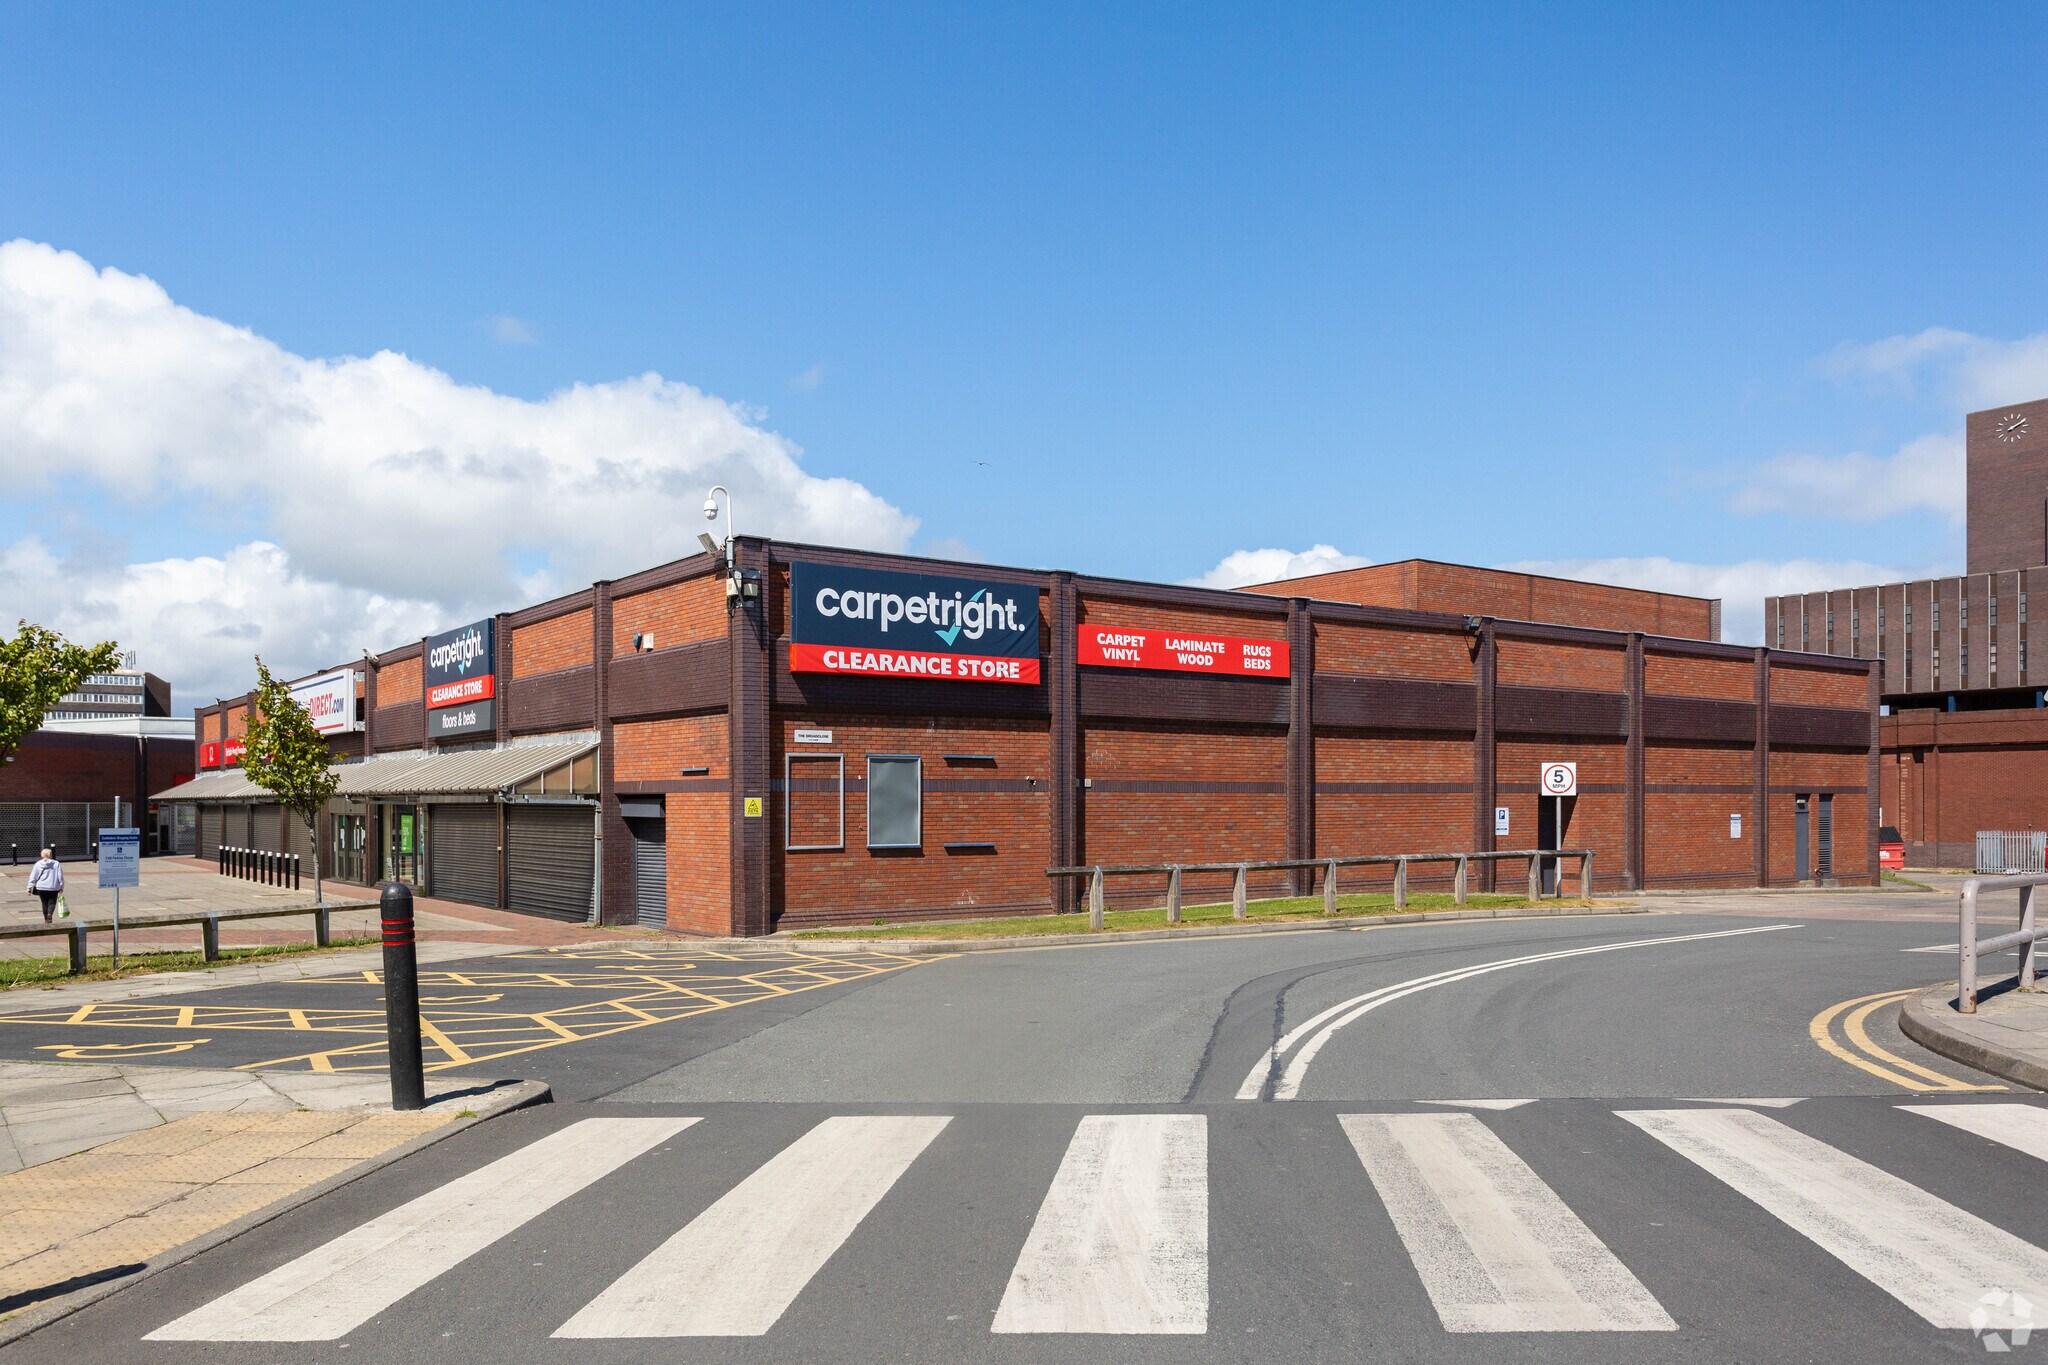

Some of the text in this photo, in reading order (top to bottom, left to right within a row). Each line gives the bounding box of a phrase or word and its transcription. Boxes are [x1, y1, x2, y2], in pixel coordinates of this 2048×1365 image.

[1096, 632, 1146, 648] CARPET
[1165, 638, 1225, 654] LAMINATE
[1102, 647, 1141, 662] VINYL
[1243, 644, 1272, 657] RUGS
[822, 650, 1021, 679] CLEARANCE STORE
[1177, 653, 1214, 666] WOOD
[1243, 657, 1272, 670] BEDS
[432, 680, 483, 703] CLEARANCE STORE
[442, 709, 476, 729] floors & beds
[1553, 770, 1564, 783] 5
